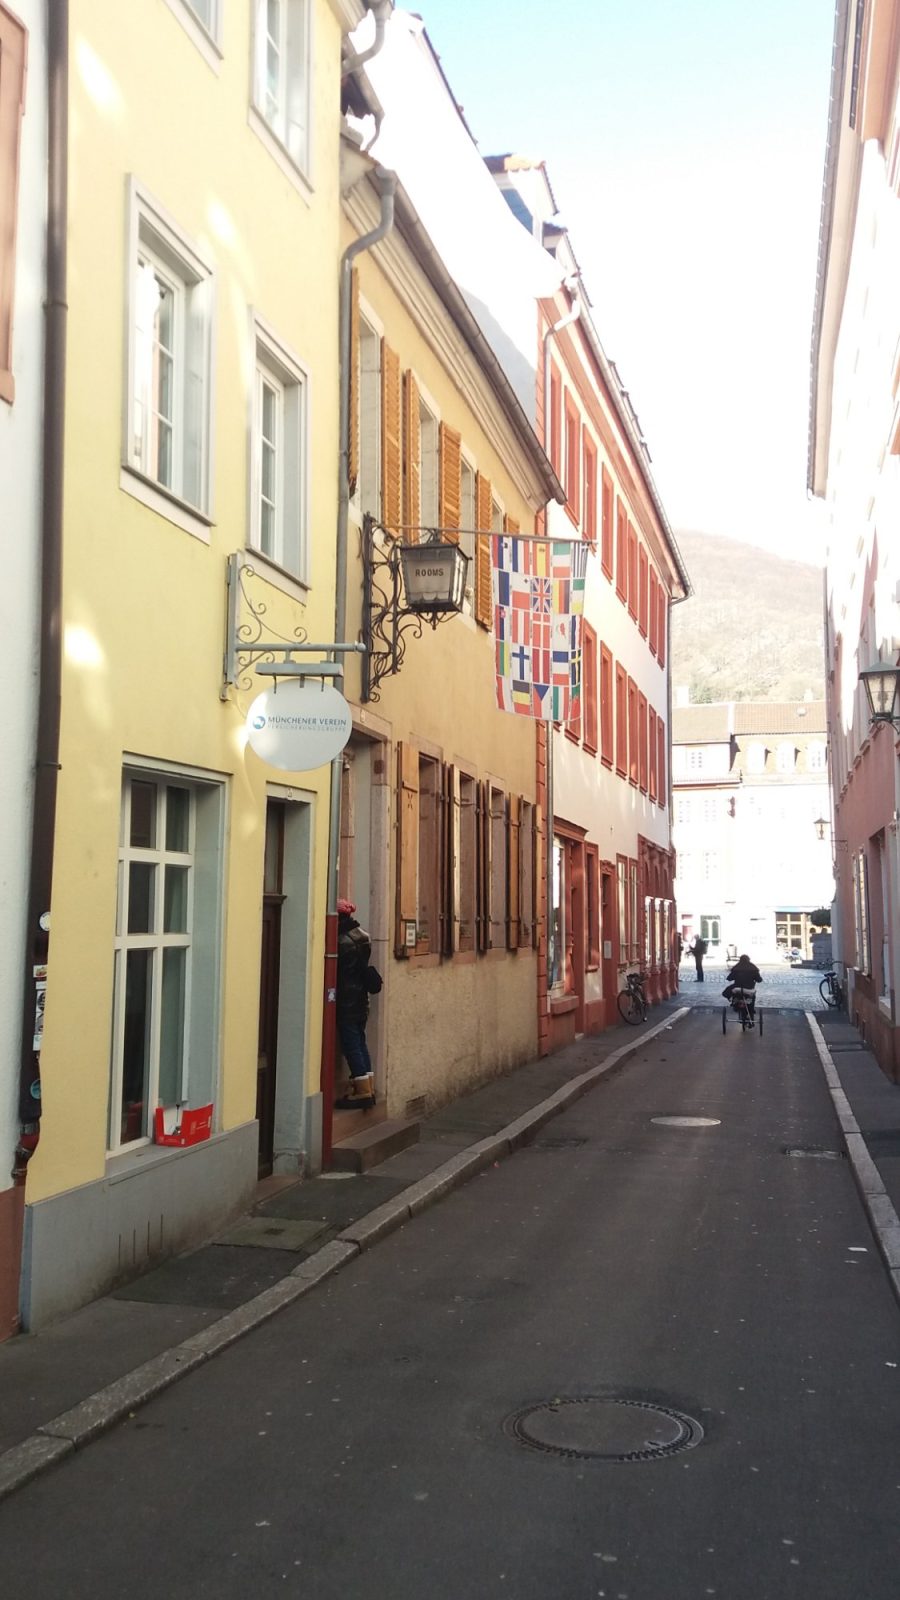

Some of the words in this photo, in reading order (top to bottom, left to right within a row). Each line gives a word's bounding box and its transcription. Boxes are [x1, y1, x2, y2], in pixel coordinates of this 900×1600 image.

[415, 568, 444, 577] ROOMS
[268, 715, 317, 725] MÜNCHENER
[319, 718, 347, 726] VEREIN
